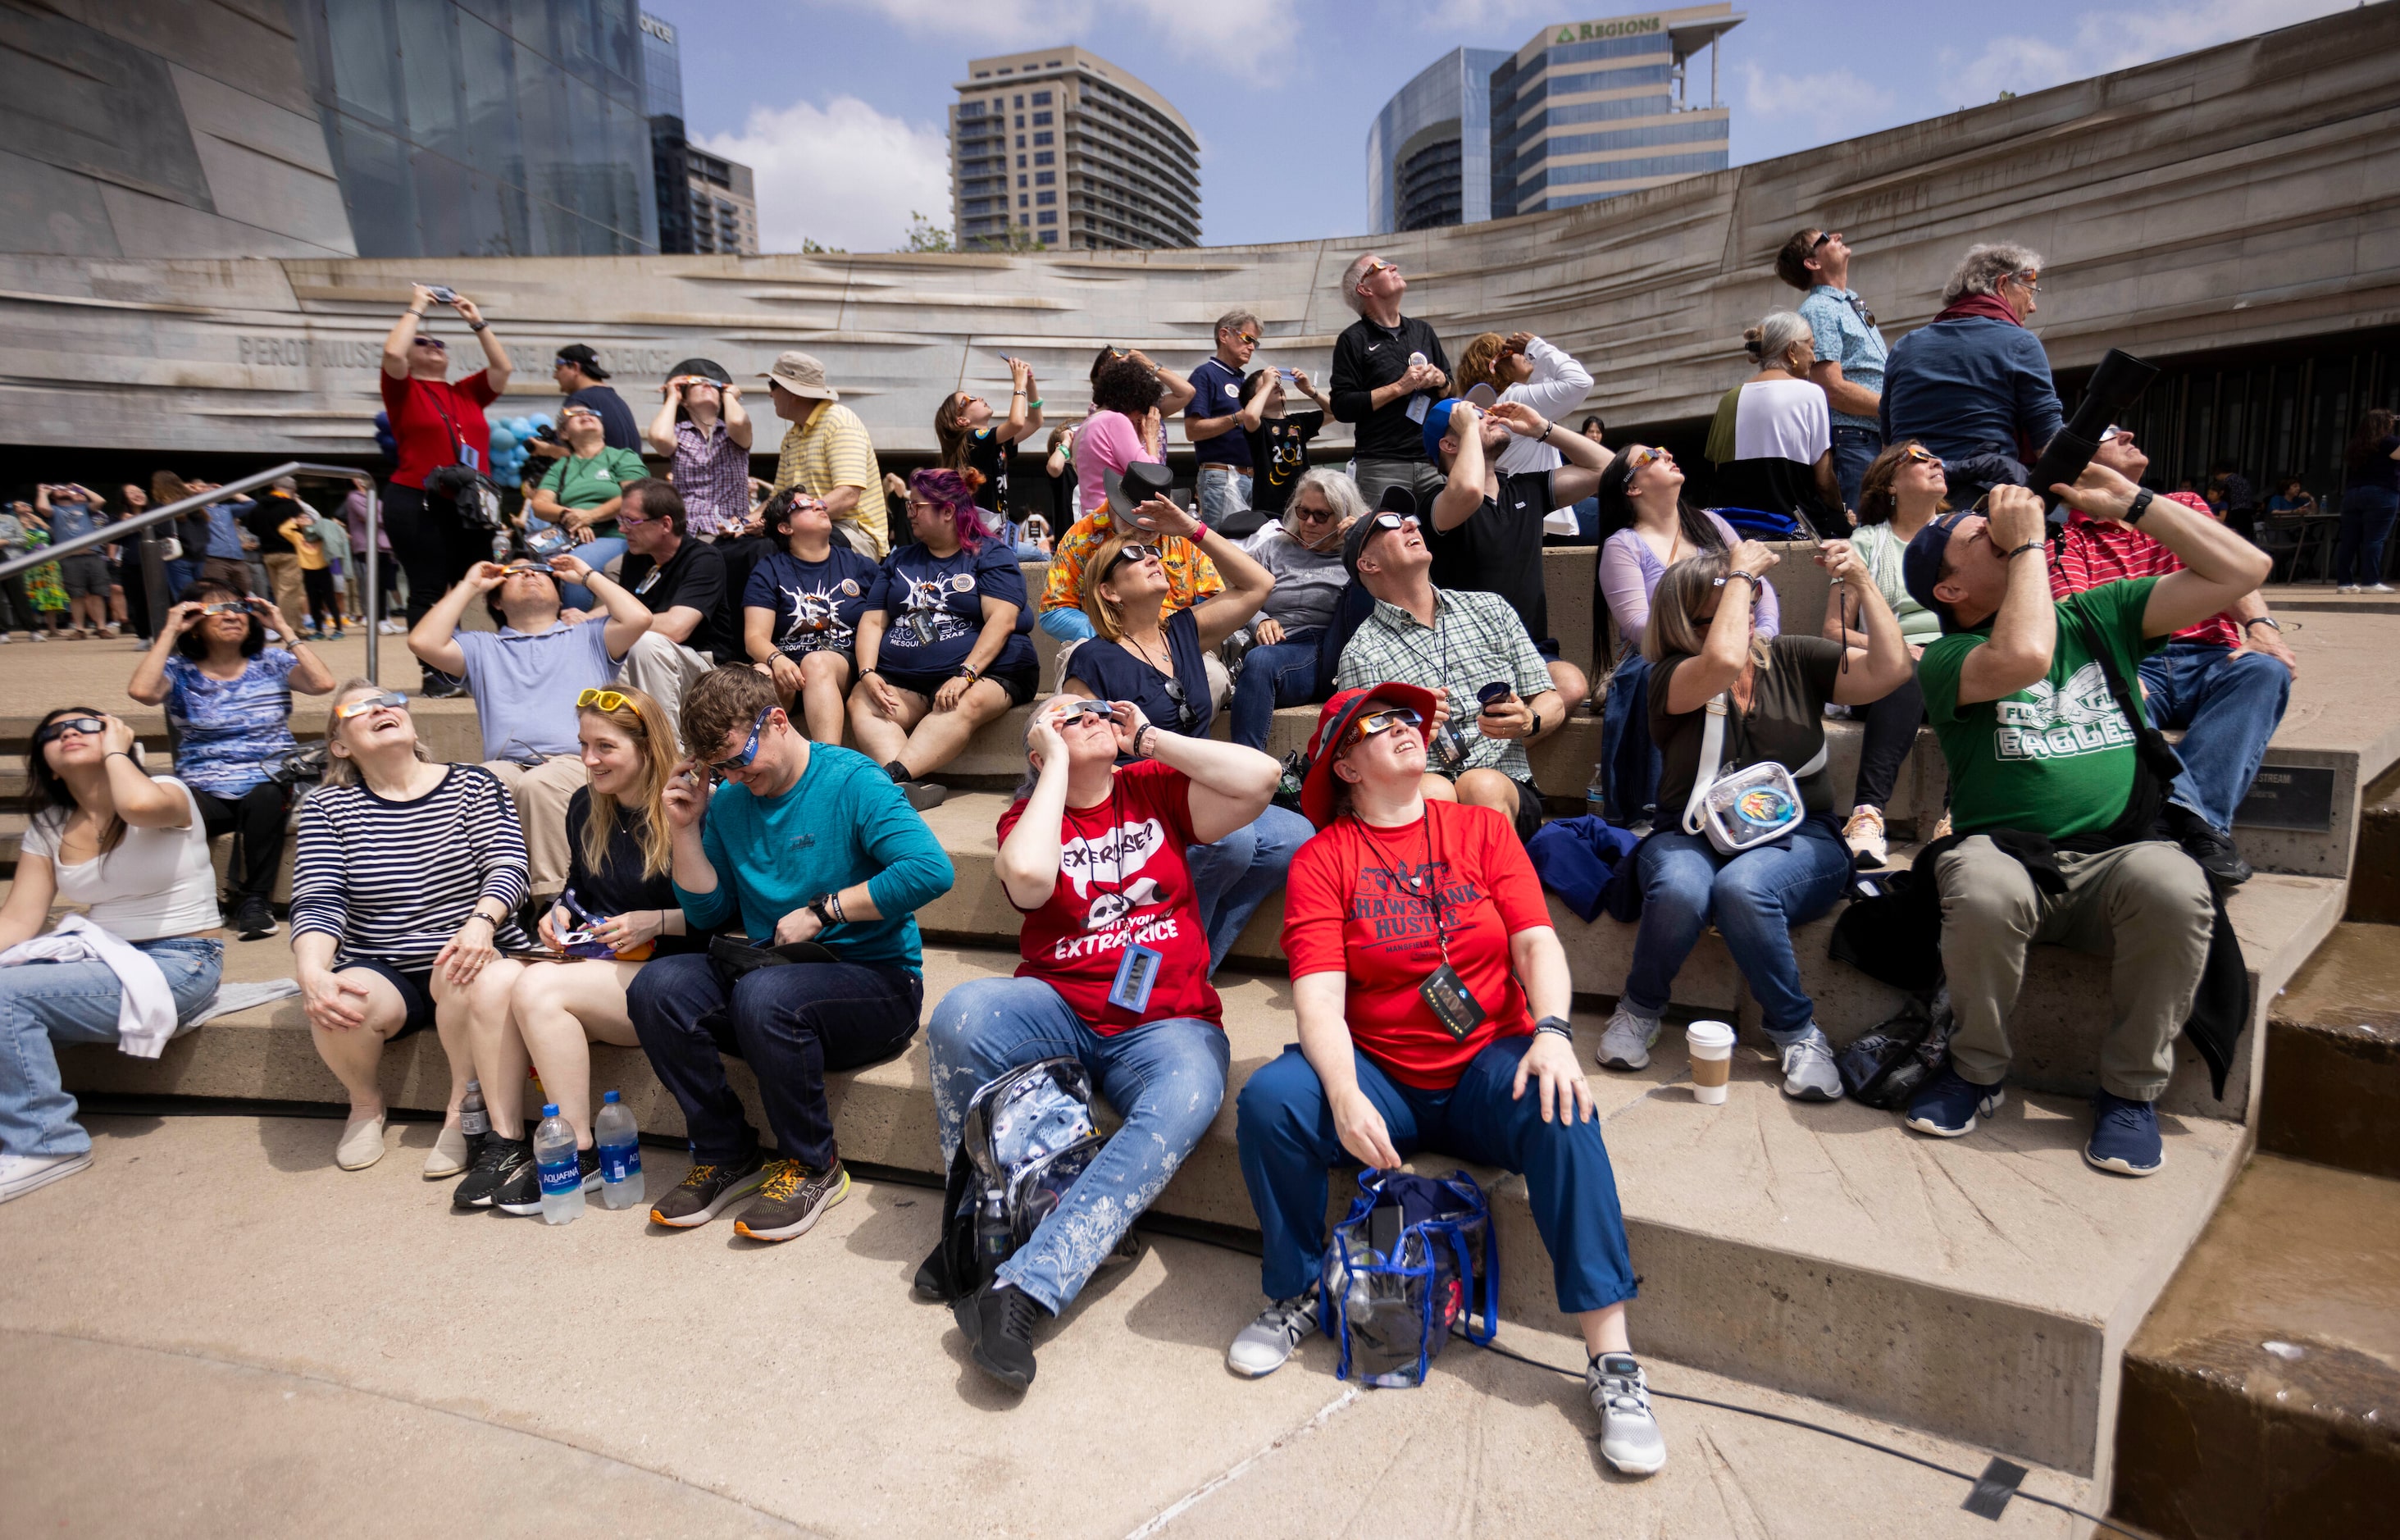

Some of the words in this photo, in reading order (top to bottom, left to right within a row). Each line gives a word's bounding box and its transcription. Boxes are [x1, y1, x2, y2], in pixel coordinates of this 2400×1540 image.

[1579, 17, 1659, 40] REGIONS
[239, 335, 313, 367] PEROT
[318, 339, 383, 369] MUSE
[603, 348, 673, 375] CIENCE
[940, 631, 964, 641] EXAS
[1994, 711, 2138, 761] EAGLES
[2258, 773, 2291, 784] STREAM
[1063, 822, 1153, 867] EXERCISE?
[1054, 930, 1132, 960] EXTRA
[1135, 919, 1178, 943] RICE
[1374, 908, 1461, 940] HUSTE
[544, 1166, 579, 1183] AQUAFINA
